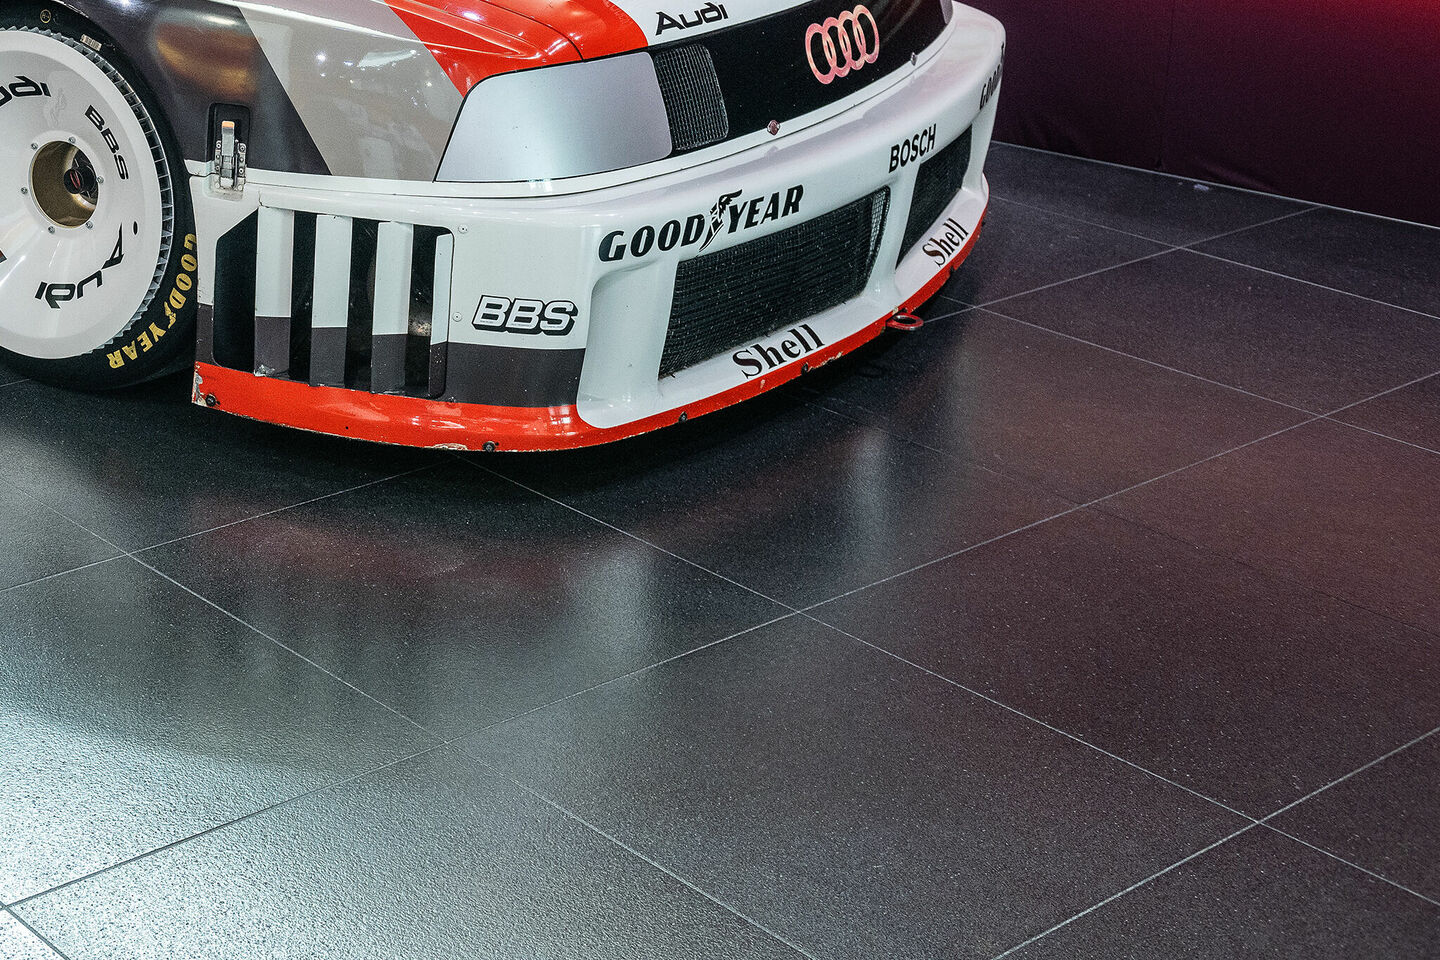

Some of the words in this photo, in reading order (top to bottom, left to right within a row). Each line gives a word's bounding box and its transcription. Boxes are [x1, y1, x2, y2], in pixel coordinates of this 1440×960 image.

[655, 3, 729, 37] Audi
[84, 104, 130, 181] BBS
[888, 124, 937, 174] BOSCH
[922, 217, 970, 268] Shell
[471, 294, 579, 337] BBS
[732, 324, 826, 380] Shell
